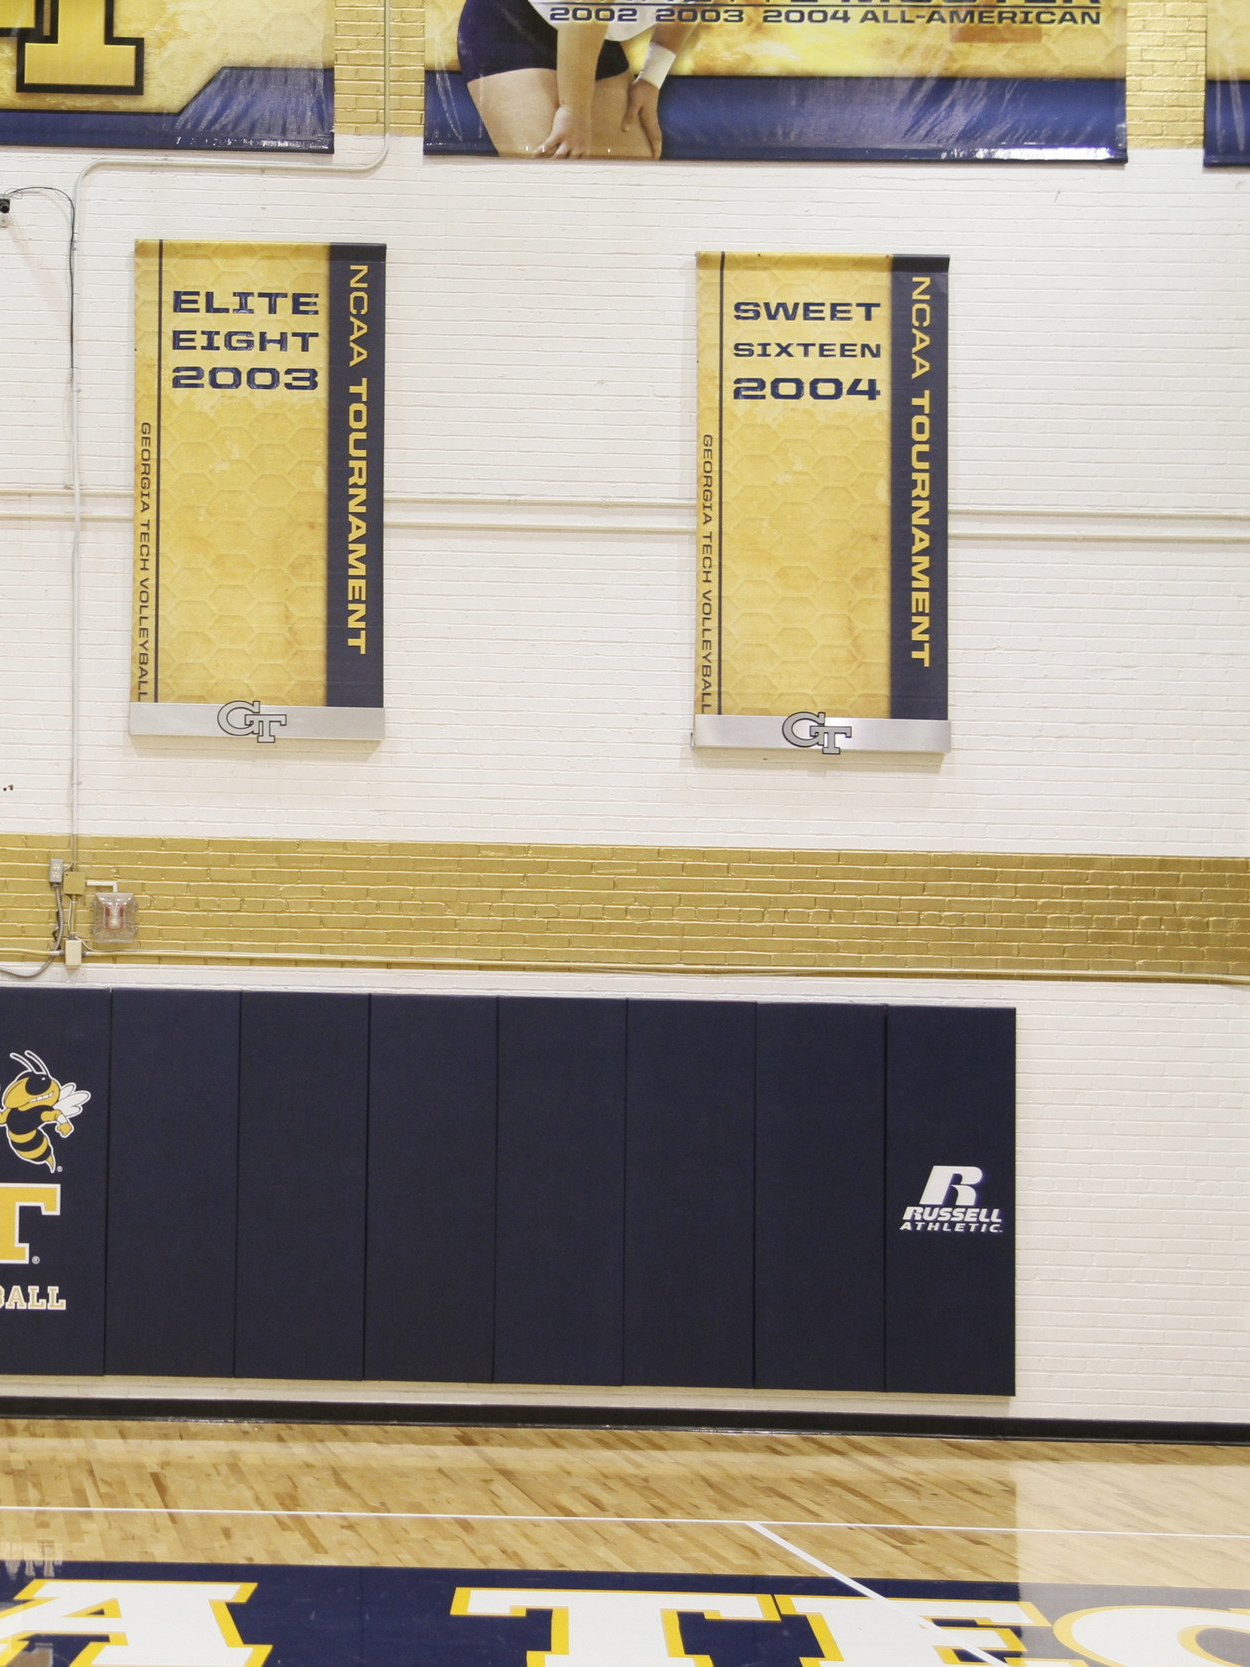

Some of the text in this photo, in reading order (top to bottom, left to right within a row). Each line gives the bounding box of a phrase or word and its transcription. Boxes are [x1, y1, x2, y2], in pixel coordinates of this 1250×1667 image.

[550, 7, 1101, 25] 2002 2003 2004 ALL-AMERICAN
[172, 290, 319, 315] ELITE
[733, 302, 881, 321] SWEET
[172, 330, 319, 352] EIGHT
[733, 342, 881, 358] SIXTEEN
[172, 366, 318, 391] 2003
[733, 378, 881, 400] 2004
[347, 264, 368, 655] NCAA TOURNAMENT
[911, 276, 931, 667] NCAA TOURNAMENT
[138, 422, 151, 702] GEORGIA TECH VOLLEYBALL
[701, 434, 713, 714] GEORGIA TECH VOLLEYBALL
[217, 700, 287, 743] GT
[781, 711, 852, 755] GT
[902, 1206, 1002, 1222] RUSSELL
[900, 1221, 1001, 1233] ATHLETIC
